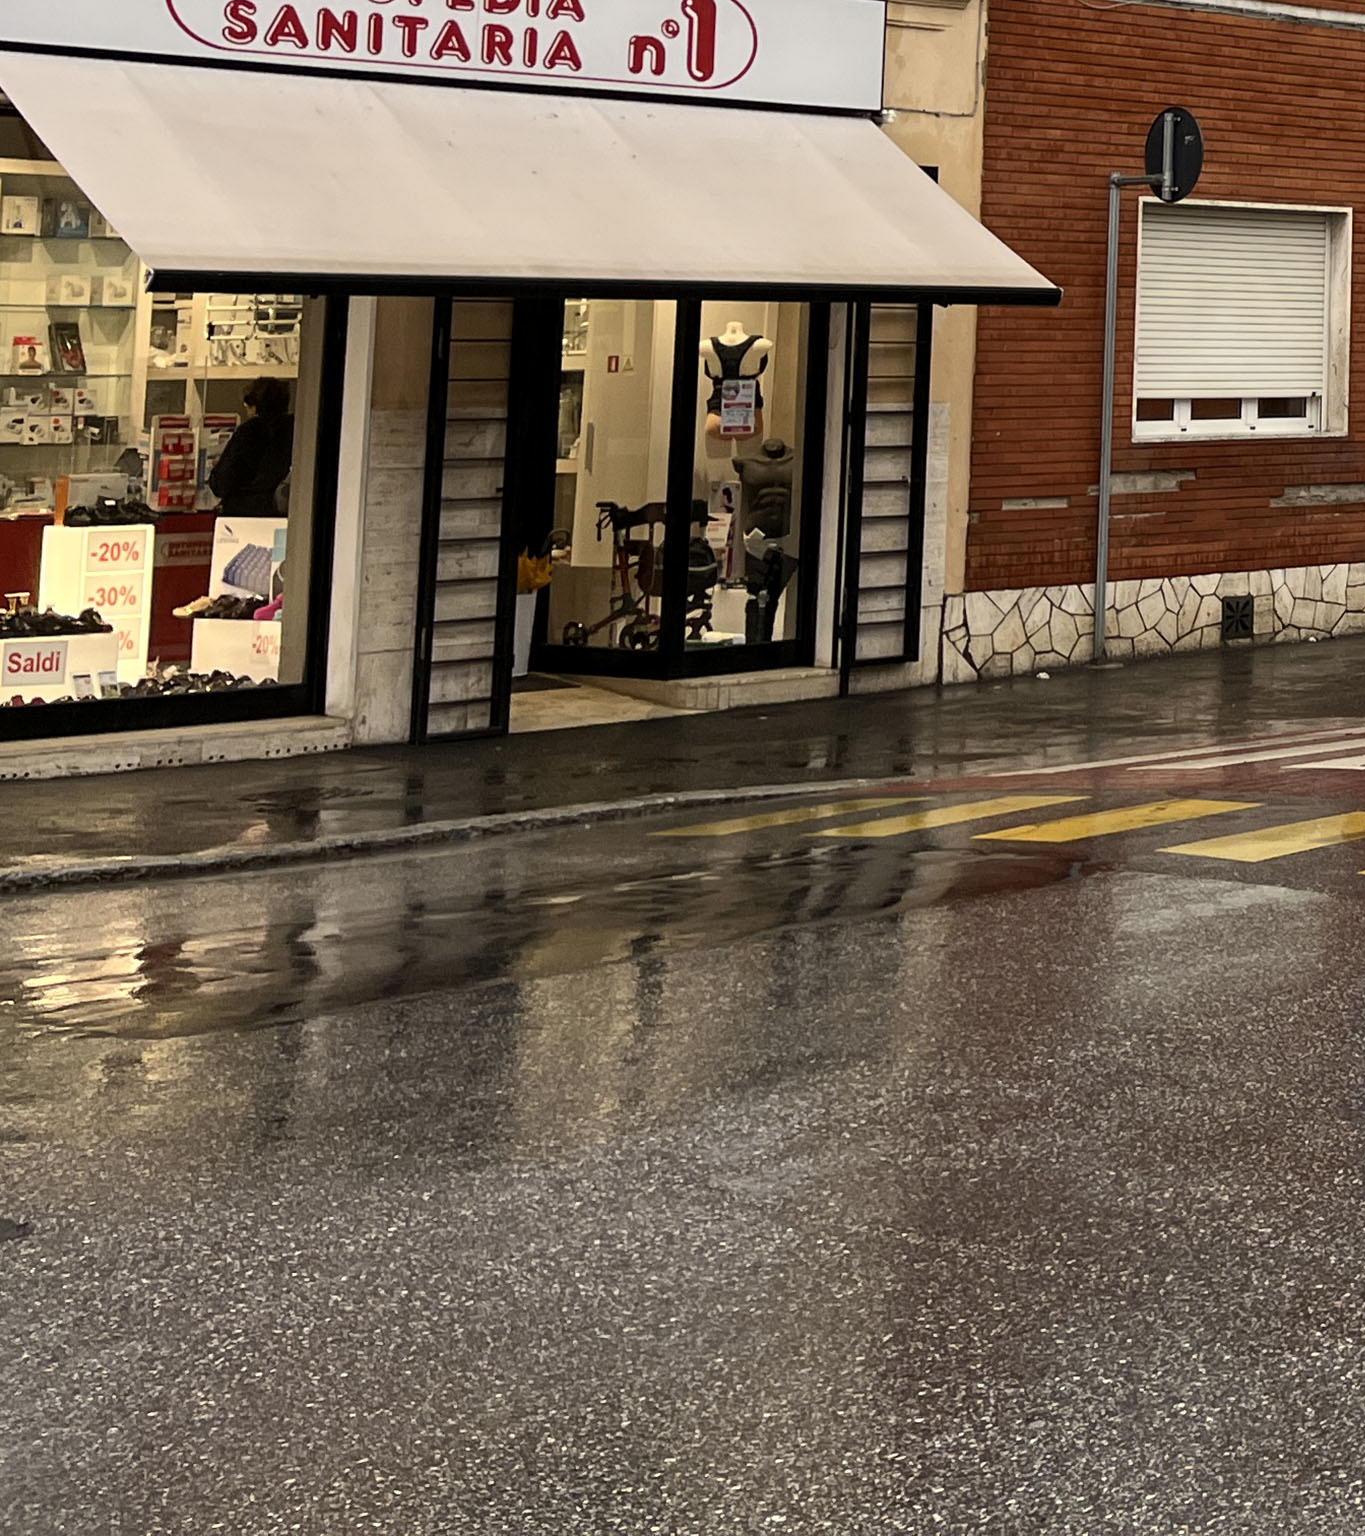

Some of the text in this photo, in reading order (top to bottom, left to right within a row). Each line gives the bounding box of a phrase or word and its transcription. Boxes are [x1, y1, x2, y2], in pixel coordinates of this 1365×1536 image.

[222, 0, 583, 72] SANITARIA
[91, 541, 139, 562] -20%
[88, 586, 137, 606] -30%
[252, 634, 279, 656] -20%
[7, 651, 61, 673] Saldi
